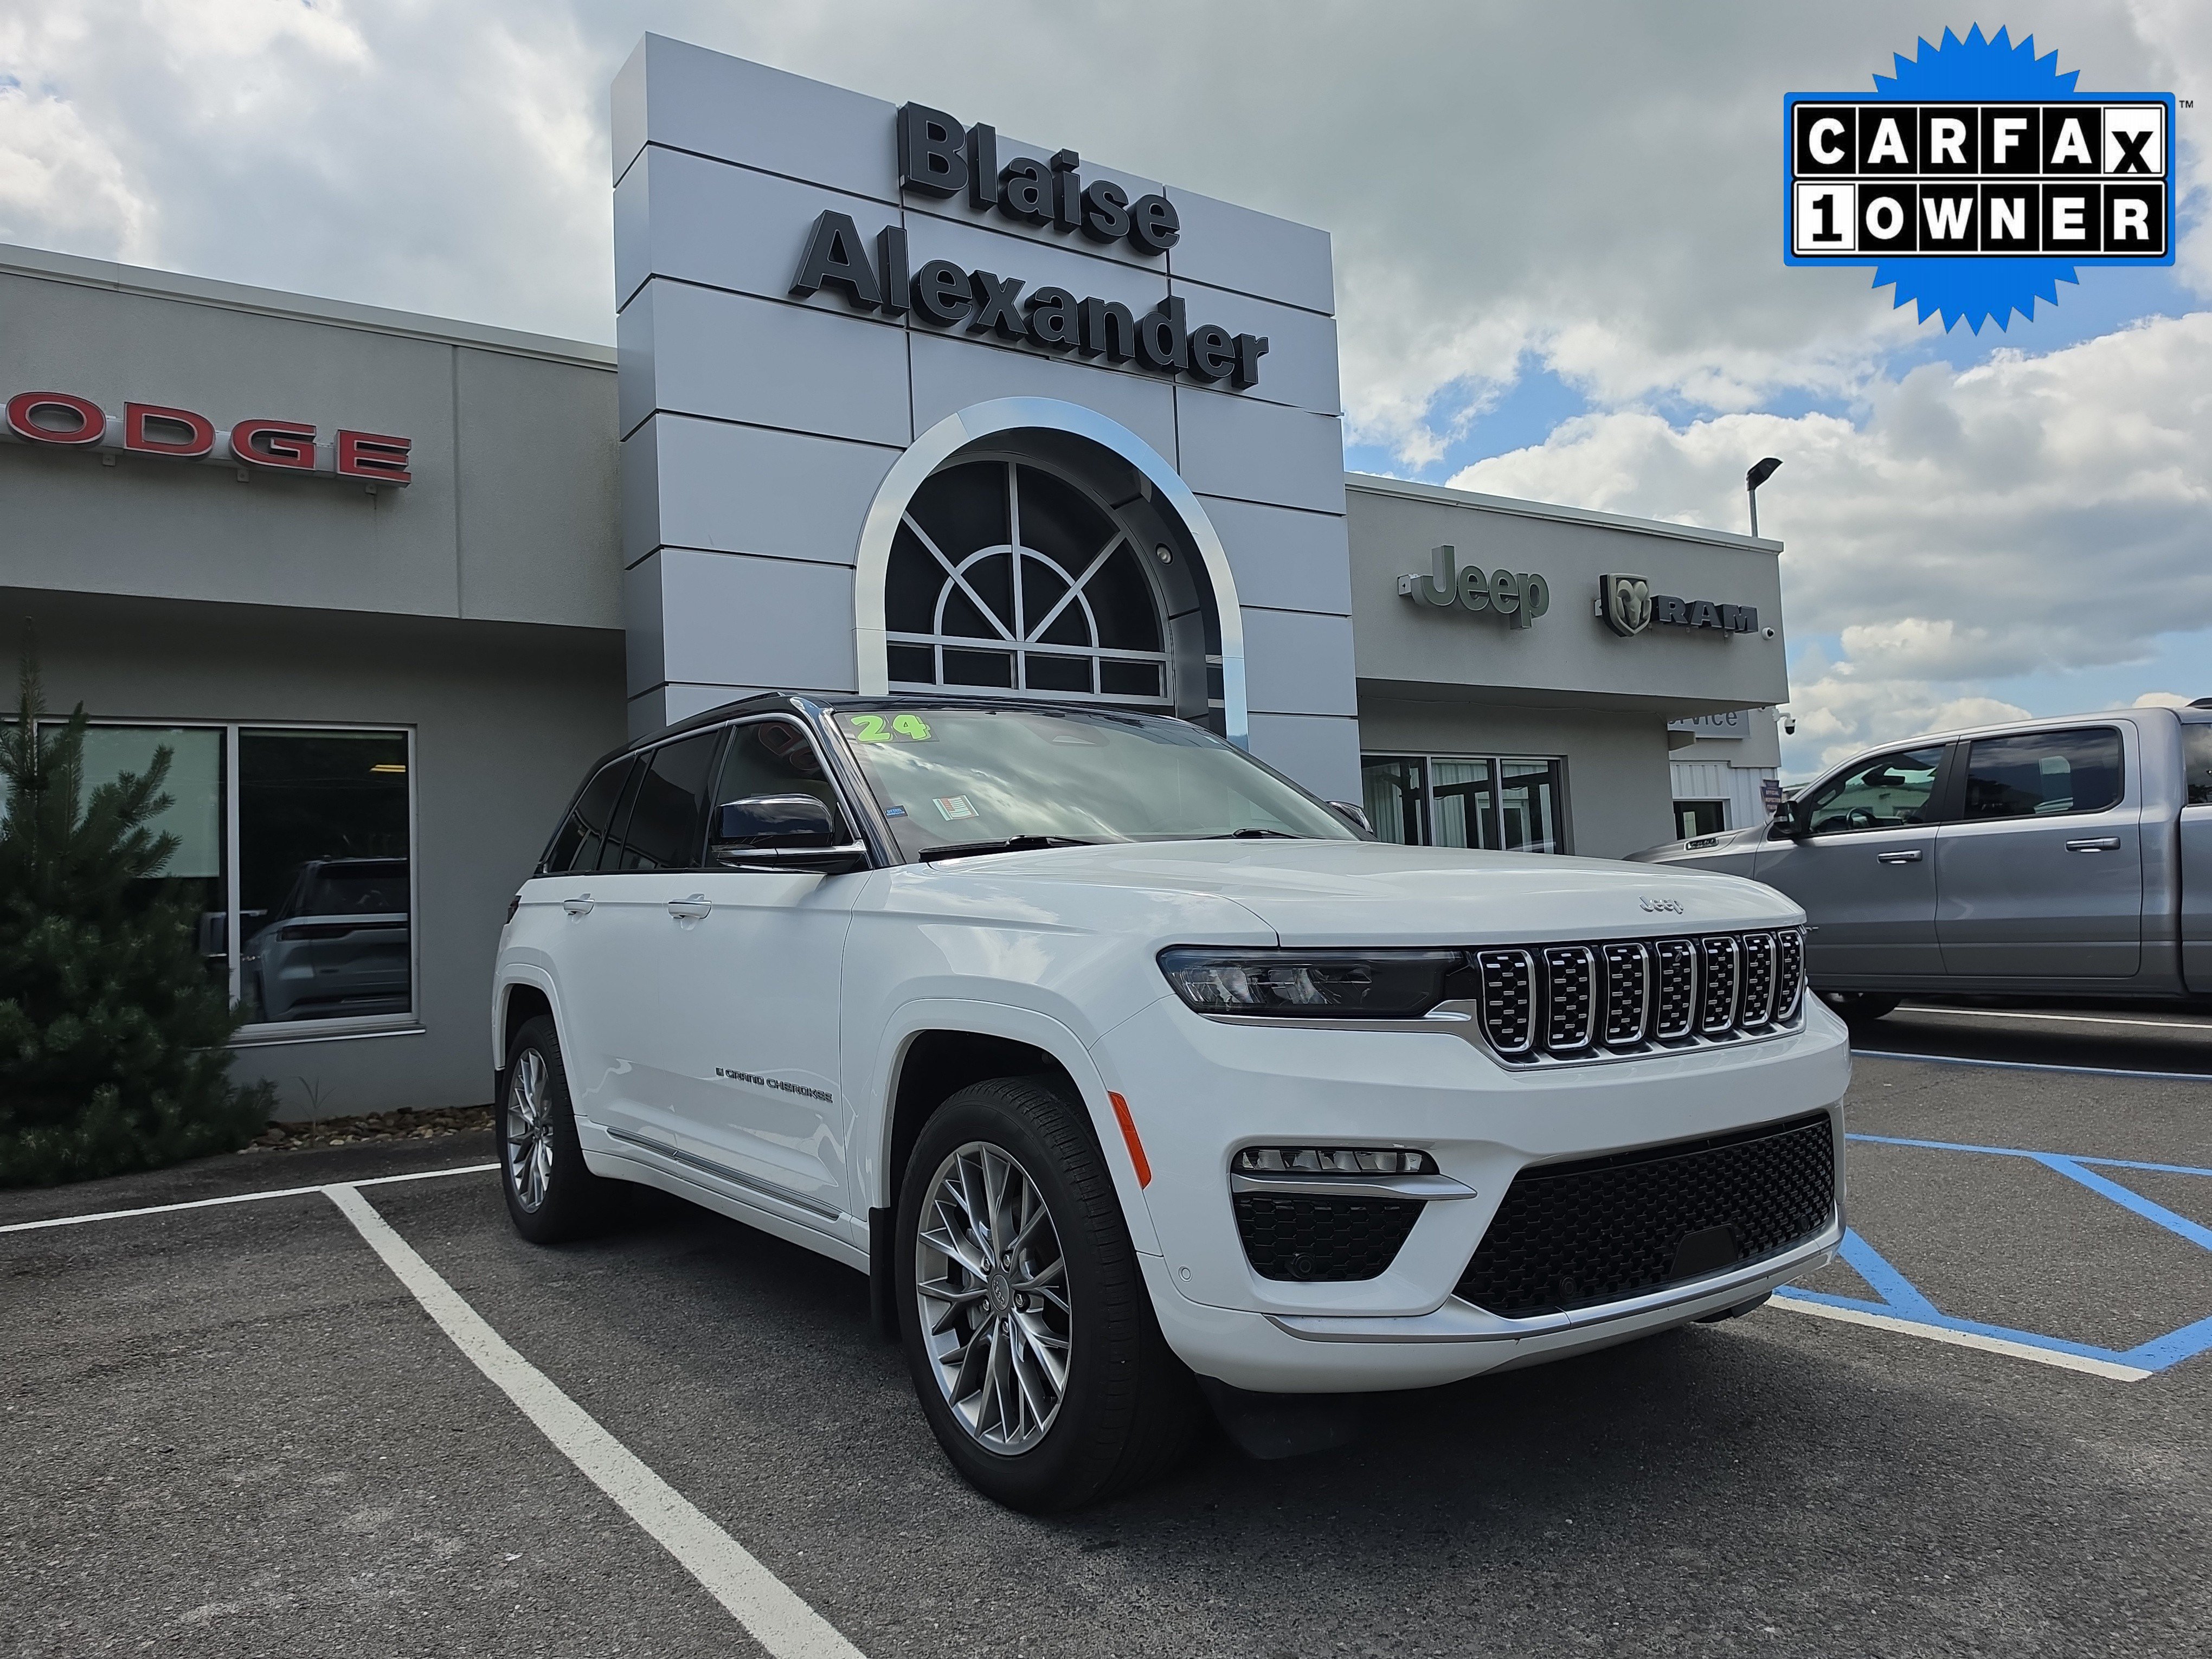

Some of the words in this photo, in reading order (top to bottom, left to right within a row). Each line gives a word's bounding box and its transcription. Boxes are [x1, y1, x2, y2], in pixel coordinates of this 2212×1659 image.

[897, 101, 1180, 256] Blaise
[788, 209, 1269, 390] Alexander
[5, 391, 412, 488] ODGE
[1411, 545, 1550, 629] Jeep
[1651, 595, 1759, 634] RAM
[850, 714, 932, 742] 24
[1668, 711, 1738, 726] vice
[1638, 895, 1684, 914] Jeep
[725, 1069, 764, 1085] GRAND
[766, 1078, 833, 1103] CHEROKEE
